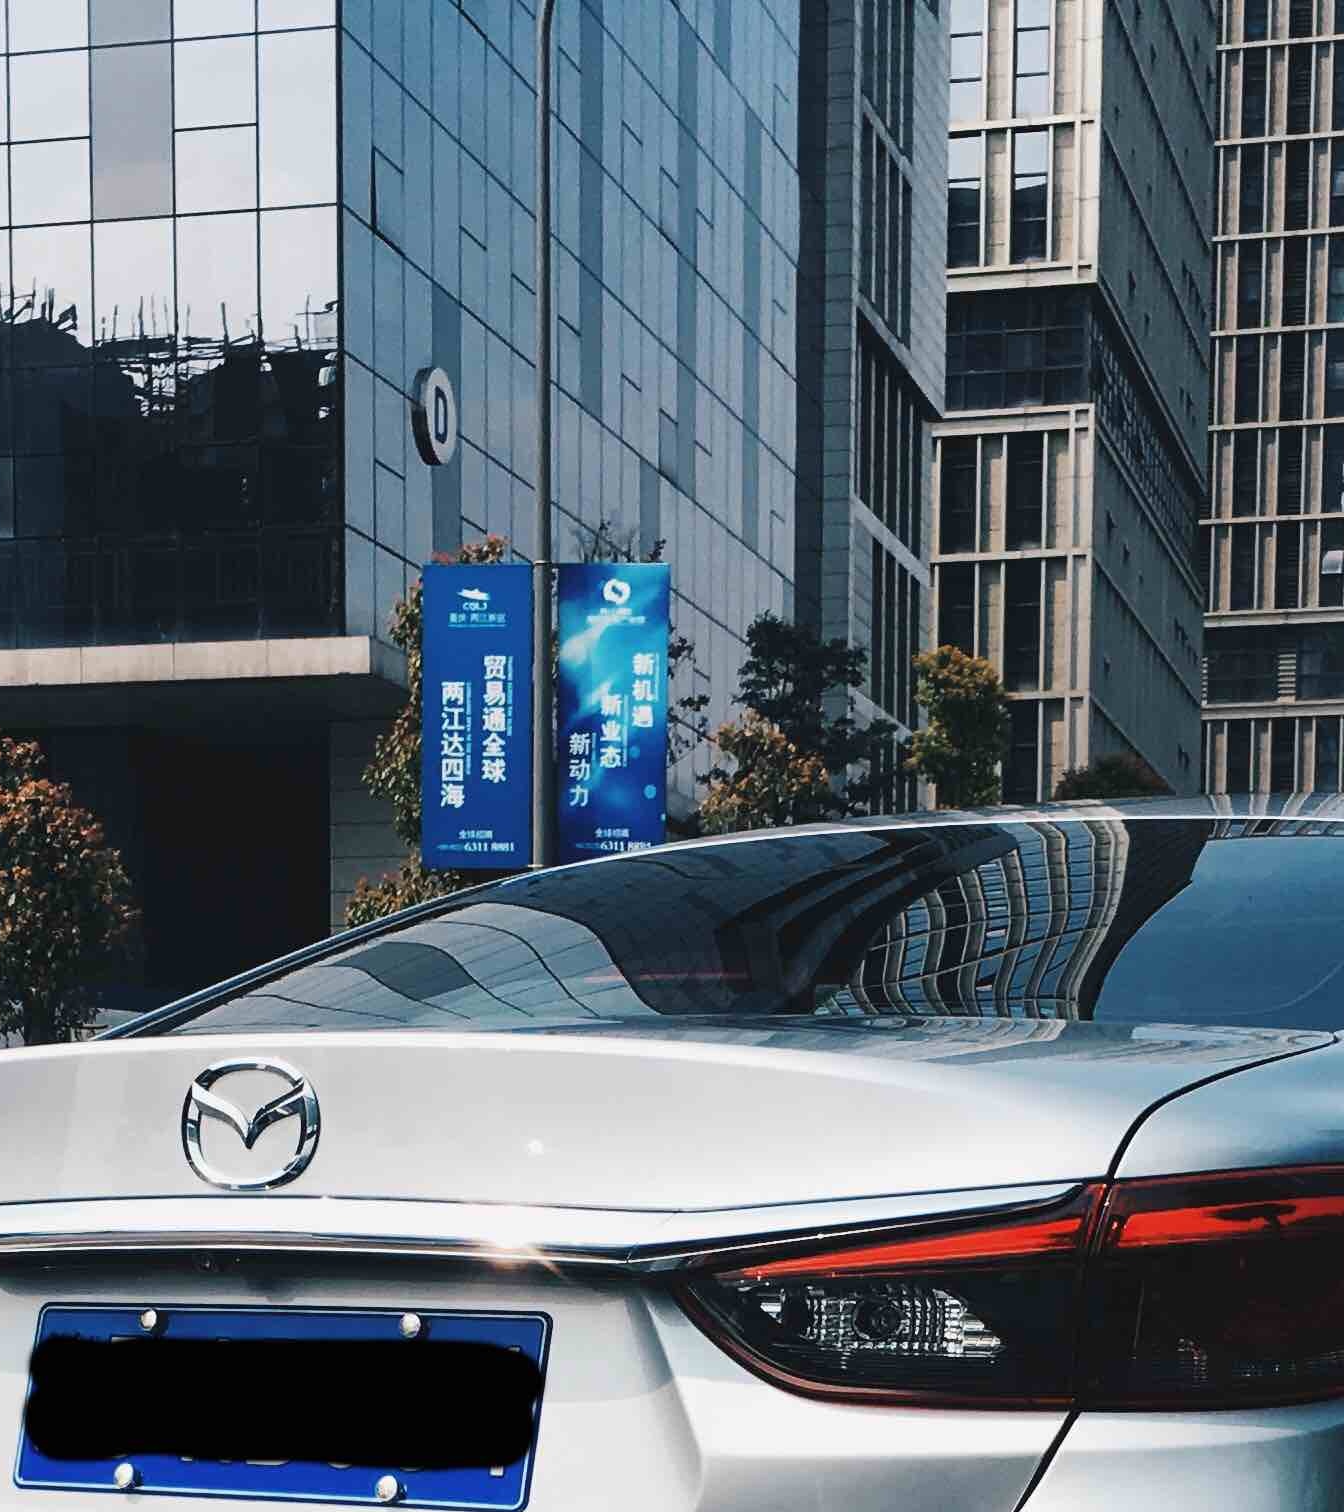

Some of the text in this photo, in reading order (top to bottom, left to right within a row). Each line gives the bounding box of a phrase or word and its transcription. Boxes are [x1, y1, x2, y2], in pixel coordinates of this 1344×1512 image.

[481, 655, 507, 784] 贸易通全球
[632, 652, 654, 728] 新机遇
[440, 681, 465, 809] 两江达四海
[600, 694, 622, 769] 新业态
[568, 732, 591, 808] 新动力
